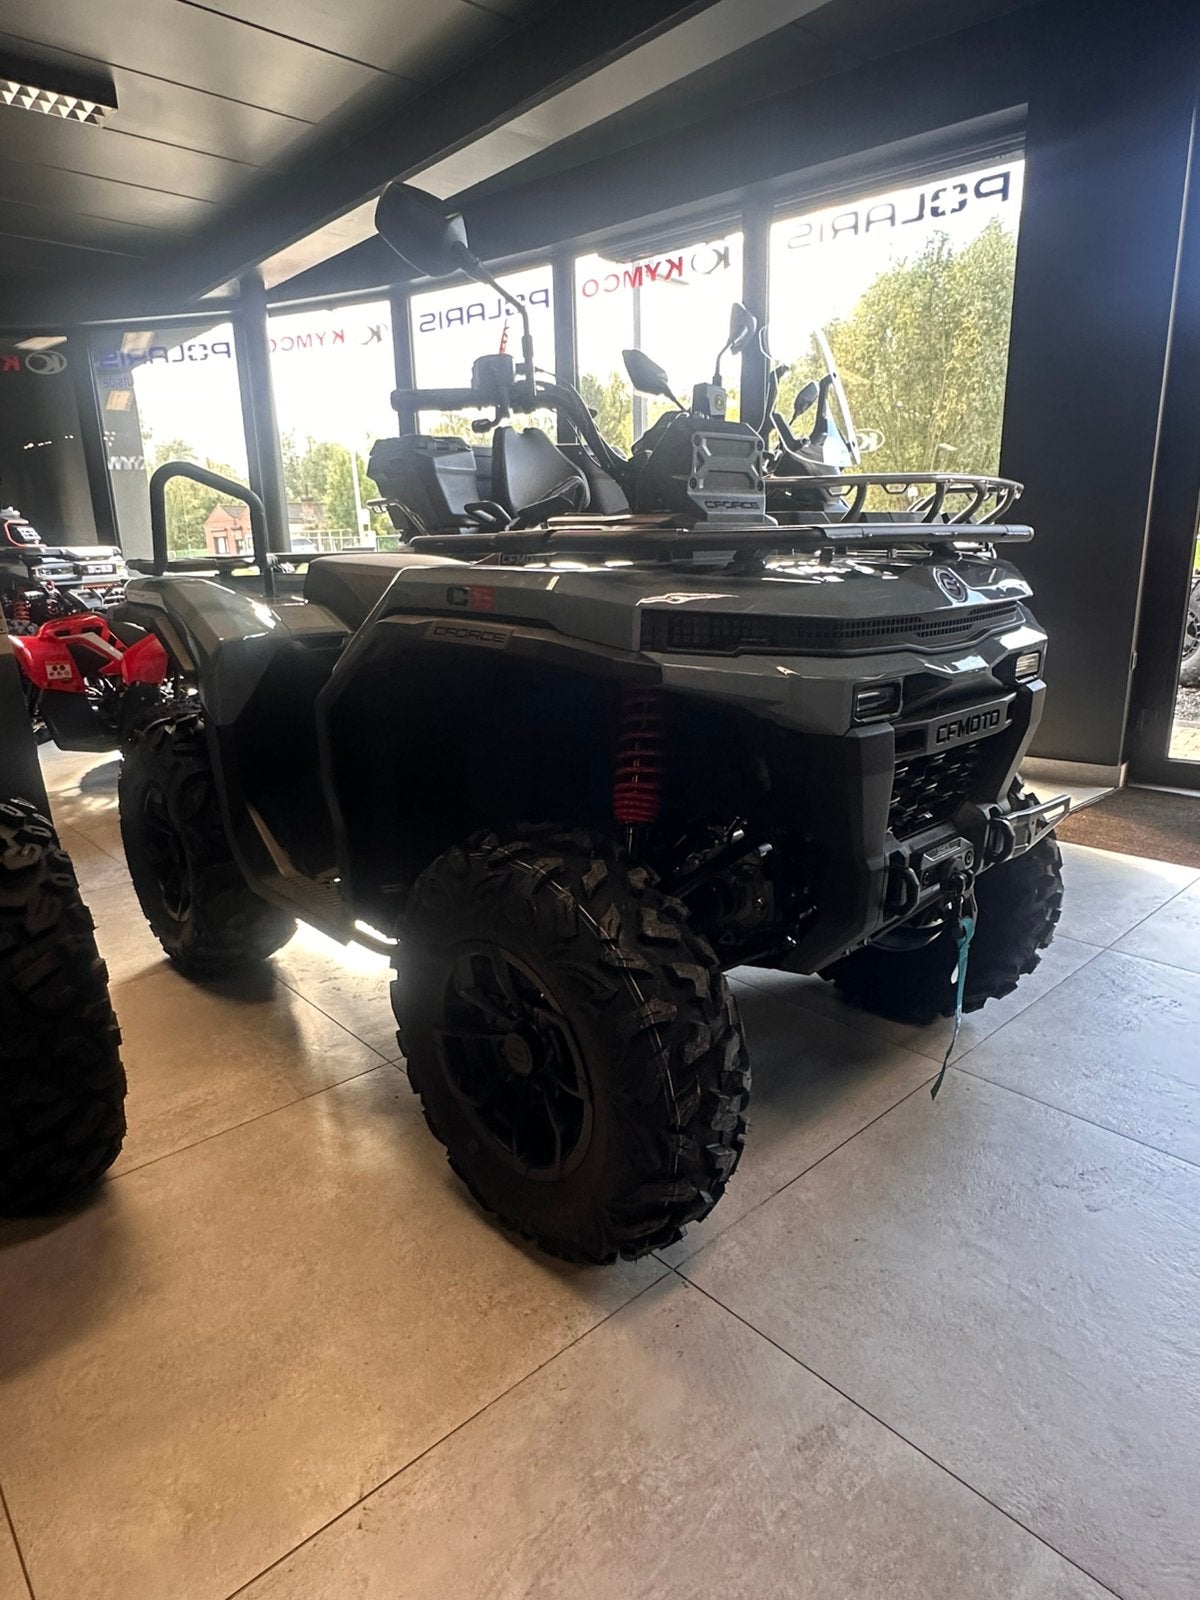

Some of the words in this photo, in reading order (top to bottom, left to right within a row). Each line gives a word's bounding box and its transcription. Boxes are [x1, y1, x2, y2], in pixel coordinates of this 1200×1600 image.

[704, 500, 760, 510] CFORCE
[433, 626, 507, 643] CFORCE
[936, 709, 1000, 744] CFMOTO
